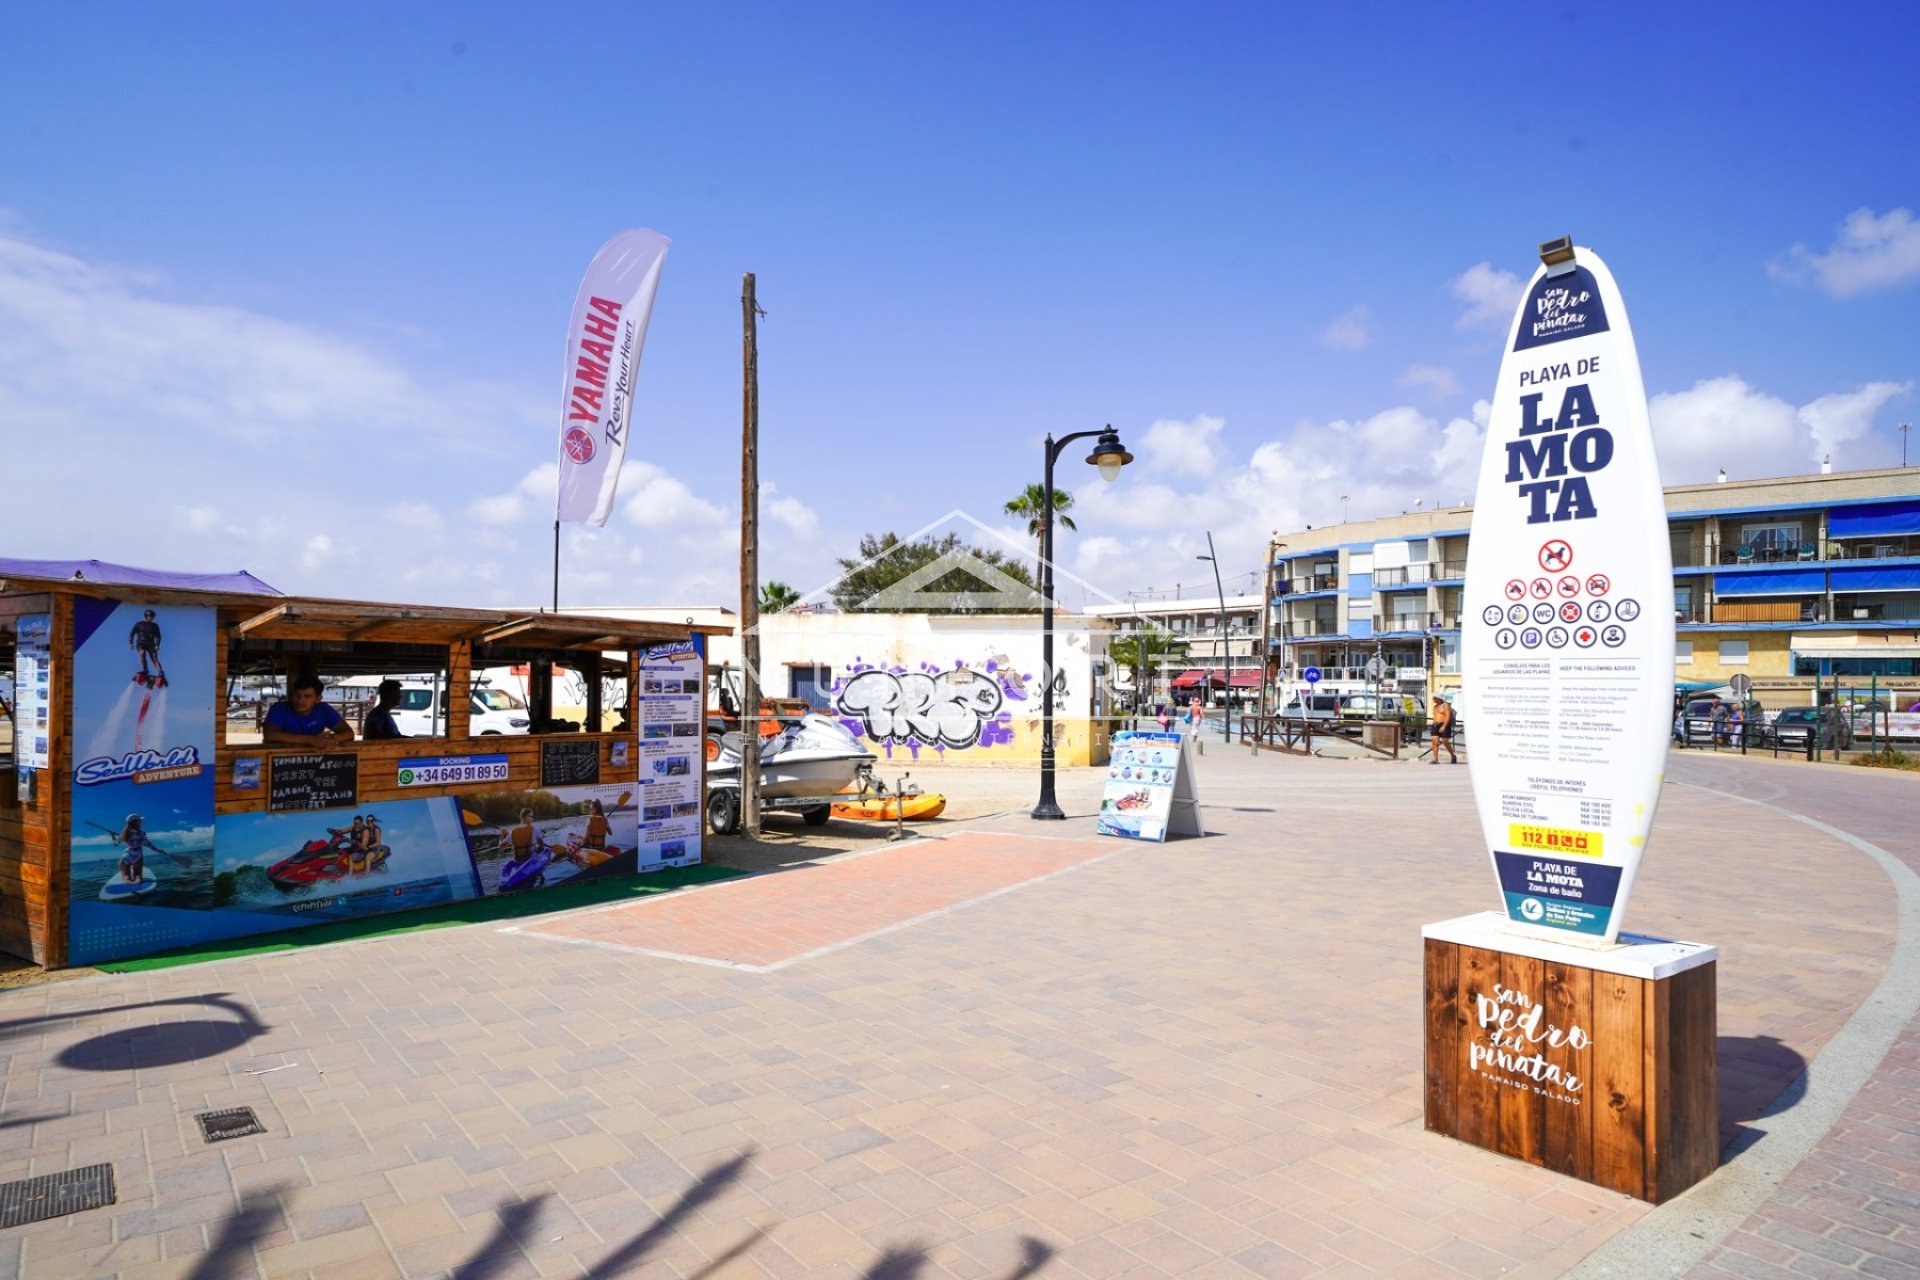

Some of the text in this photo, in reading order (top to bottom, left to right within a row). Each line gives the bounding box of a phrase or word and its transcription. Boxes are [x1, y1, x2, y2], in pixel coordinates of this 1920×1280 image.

[568, 296, 622, 423] YAMAHA
[1520, 356, 1600, 387] PLAYA DE
[606, 320, 636, 447] Revs Your Heart
[1519, 383, 1600, 437] LA
[1505, 427, 1614, 483] MO
[1518, 476, 1597, 524] TA
[77, 746, 196, 784] SeaWorld
[273, 756, 324, 767] TOMORROW
[439, 757, 470, 765] BOOKING
[138, 766, 200, 783] ADVENTURE
[416, 765, 506, 782] +34 649 91 89 50
[310, 790, 352, 800] ISLAND
[1522, 832, 1542, 844] 112
[1526, 871, 1584, 888] LA MOTA
[1533, 861, 1577, 876] PLAYA DE
[1528, 883, 1582, 898] Zona de baño
[1477, 993, 1592, 1050] Pedro
[1490, 1028, 1524, 1052] del
[1482, 1072, 1580, 1105] PARAISO SALADO
